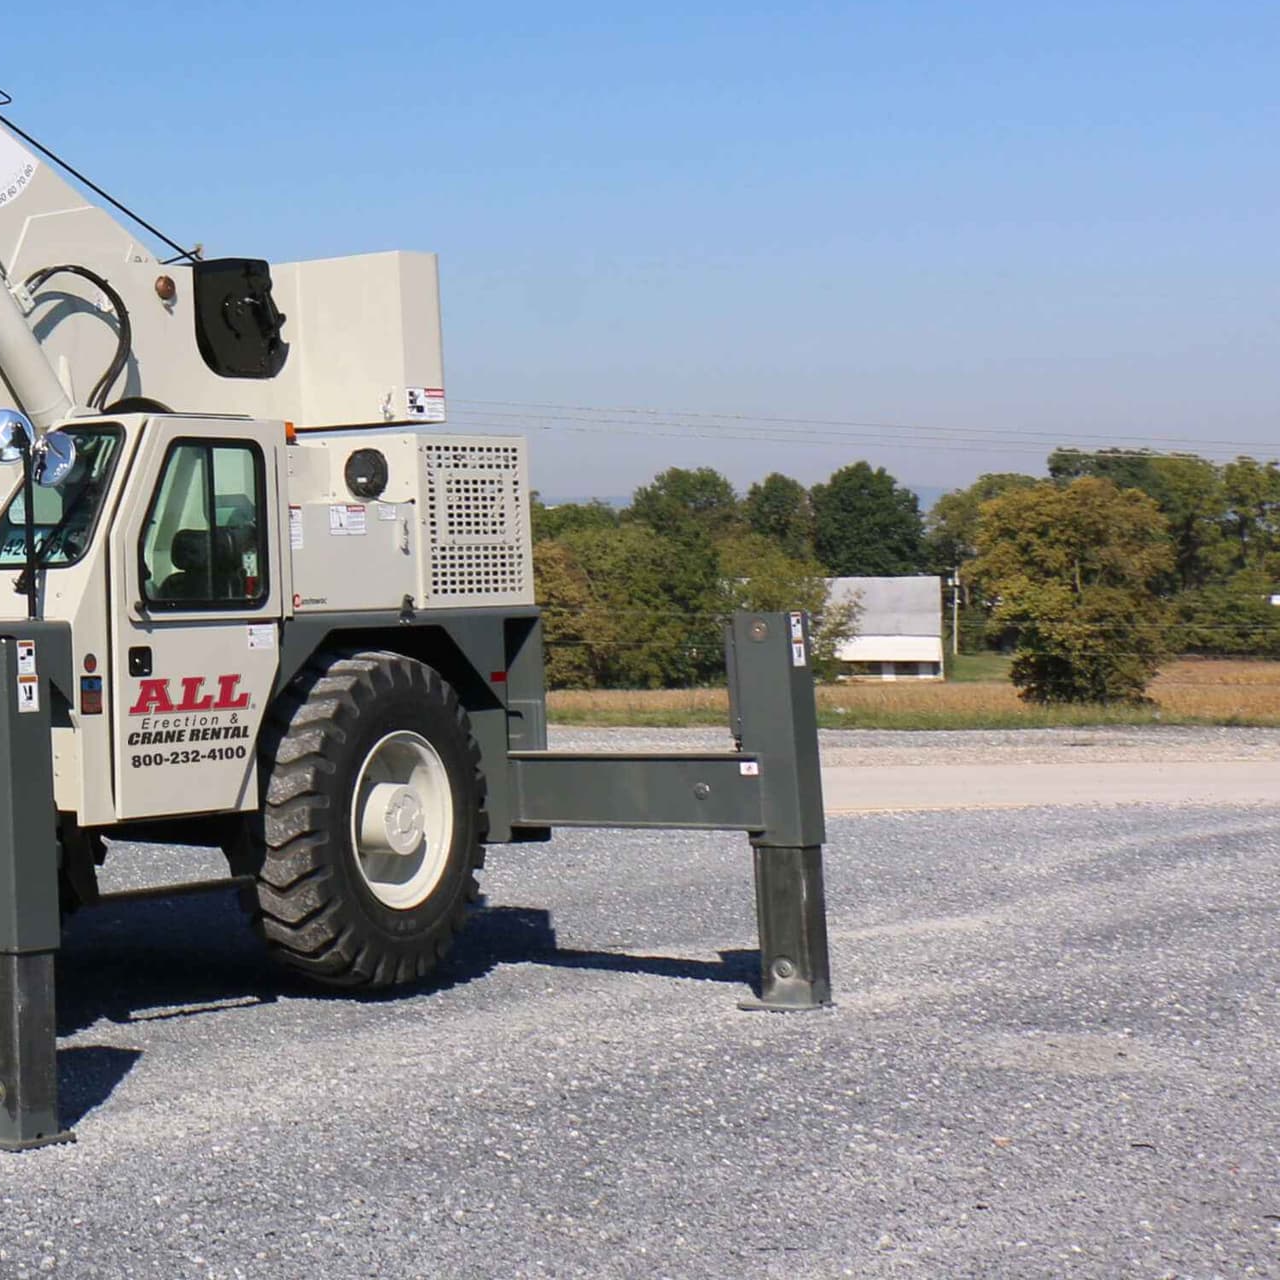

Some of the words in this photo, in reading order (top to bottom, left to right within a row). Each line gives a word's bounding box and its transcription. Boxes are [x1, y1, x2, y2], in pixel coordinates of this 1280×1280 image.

[7, 185, 17, 197] 60
[16, 175, 26, 187] 70
[129, 673, 251, 716] ALL
[141, 715, 219, 729] Erection
[230, 713, 238, 724] &
[128, 730, 186, 745] CRANE
[189, 726, 249, 741] RENTAL
[132, 746, 246, 768] 800-232-4100
